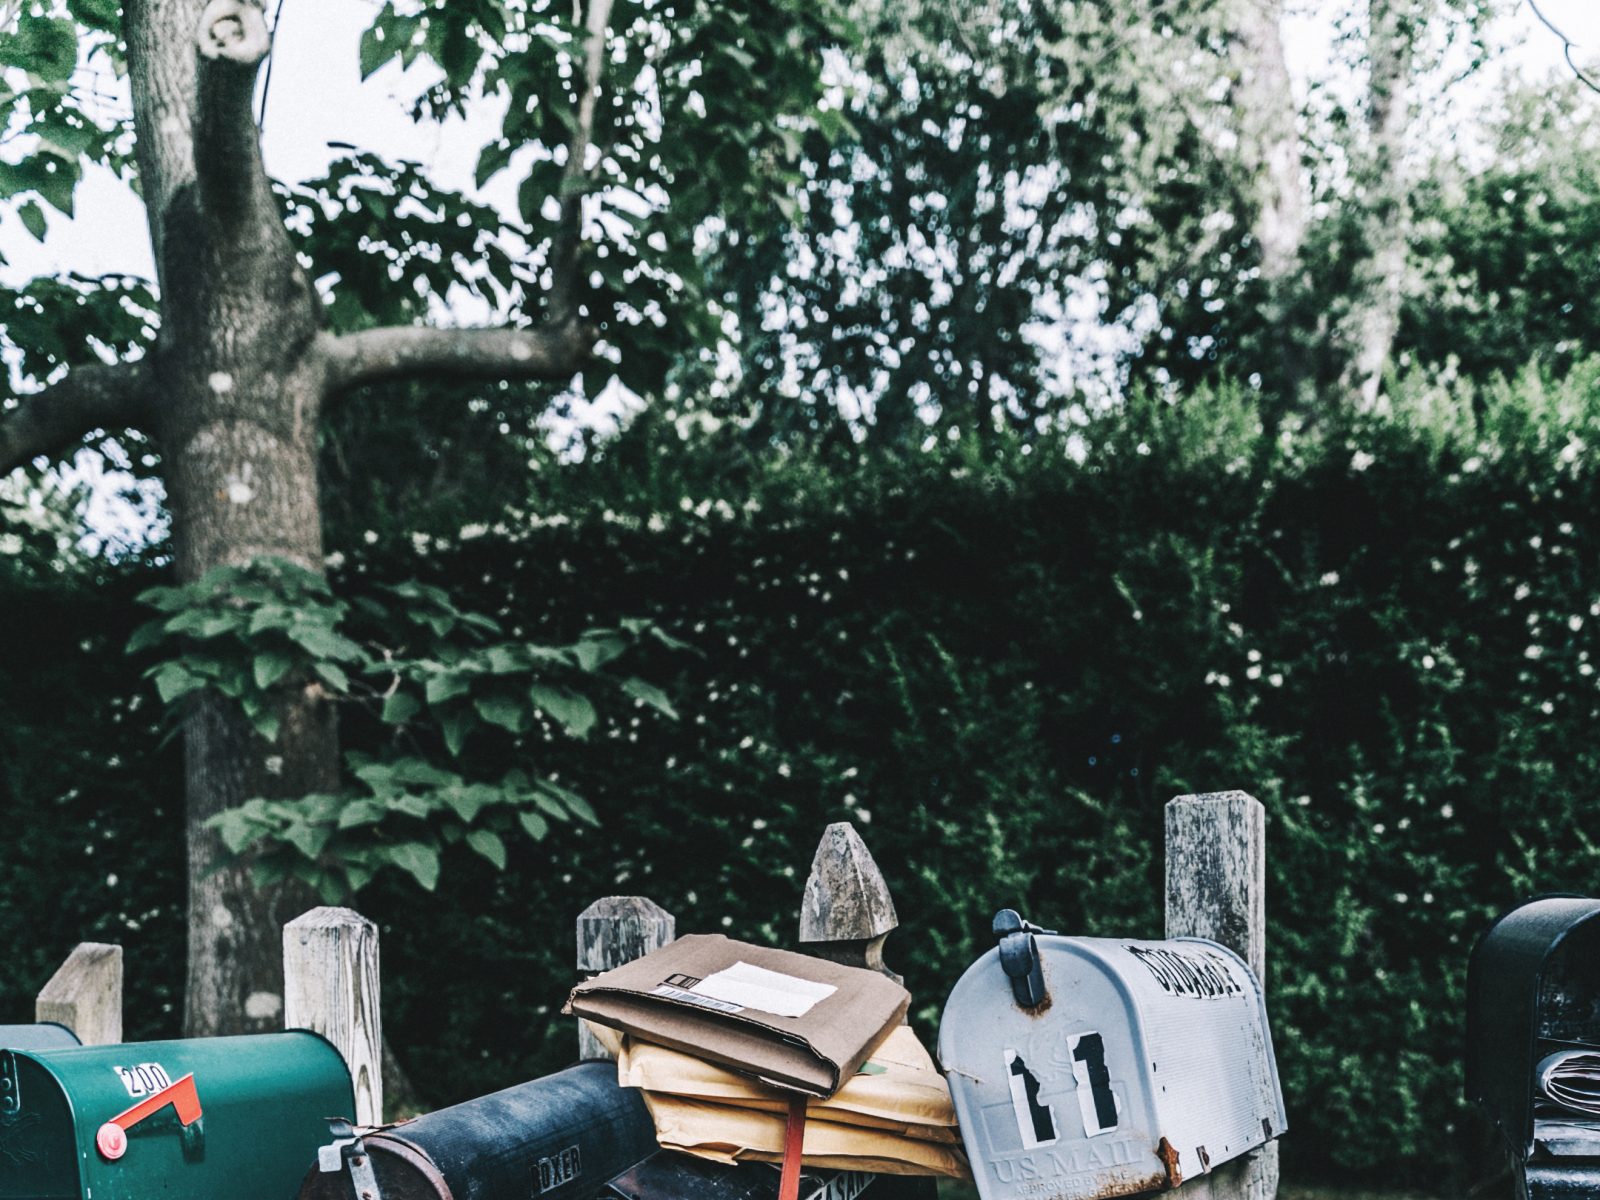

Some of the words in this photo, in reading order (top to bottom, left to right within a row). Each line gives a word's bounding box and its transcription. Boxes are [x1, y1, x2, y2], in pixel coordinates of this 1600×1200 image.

[121, 1065, 168, 1094] 200
[1010, 1032, 1119, 1143] 11
[989, 1155, 1043, 1184] U.S.
[1047, 1139, 1145, 1178] MAIL
[1015, 1178, 1081, 1196] APPROVED
